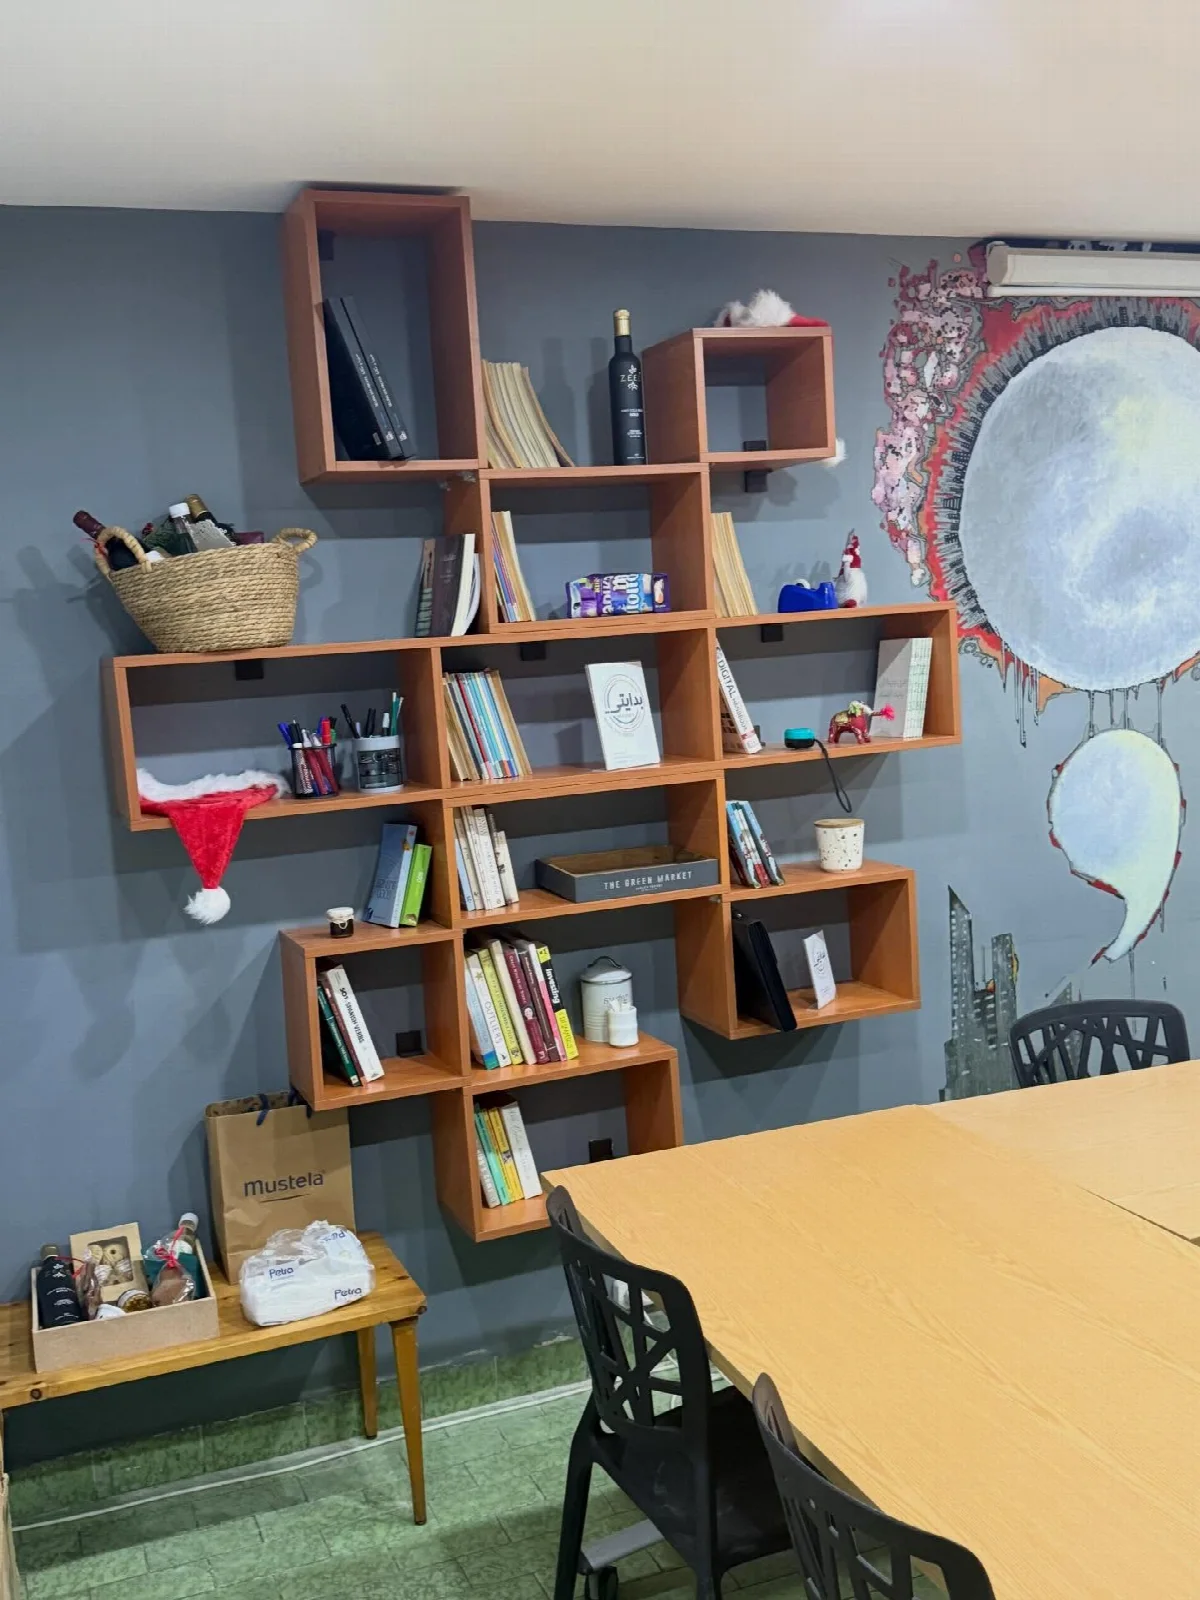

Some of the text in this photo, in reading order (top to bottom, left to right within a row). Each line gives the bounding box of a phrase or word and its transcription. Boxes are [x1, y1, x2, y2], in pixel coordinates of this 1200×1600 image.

[717, 660, 737, 698] DIGITAL
[603, 881, 621, 891] THE
[624, 876, 653, 888] GREEN
[657, 871, 693, 884] MARKET
[545, 967, 561, 1005] Investing
[484, 1001, 501, 1044] OUTLIERS
[334, 1287, 363, 1301] Petro
